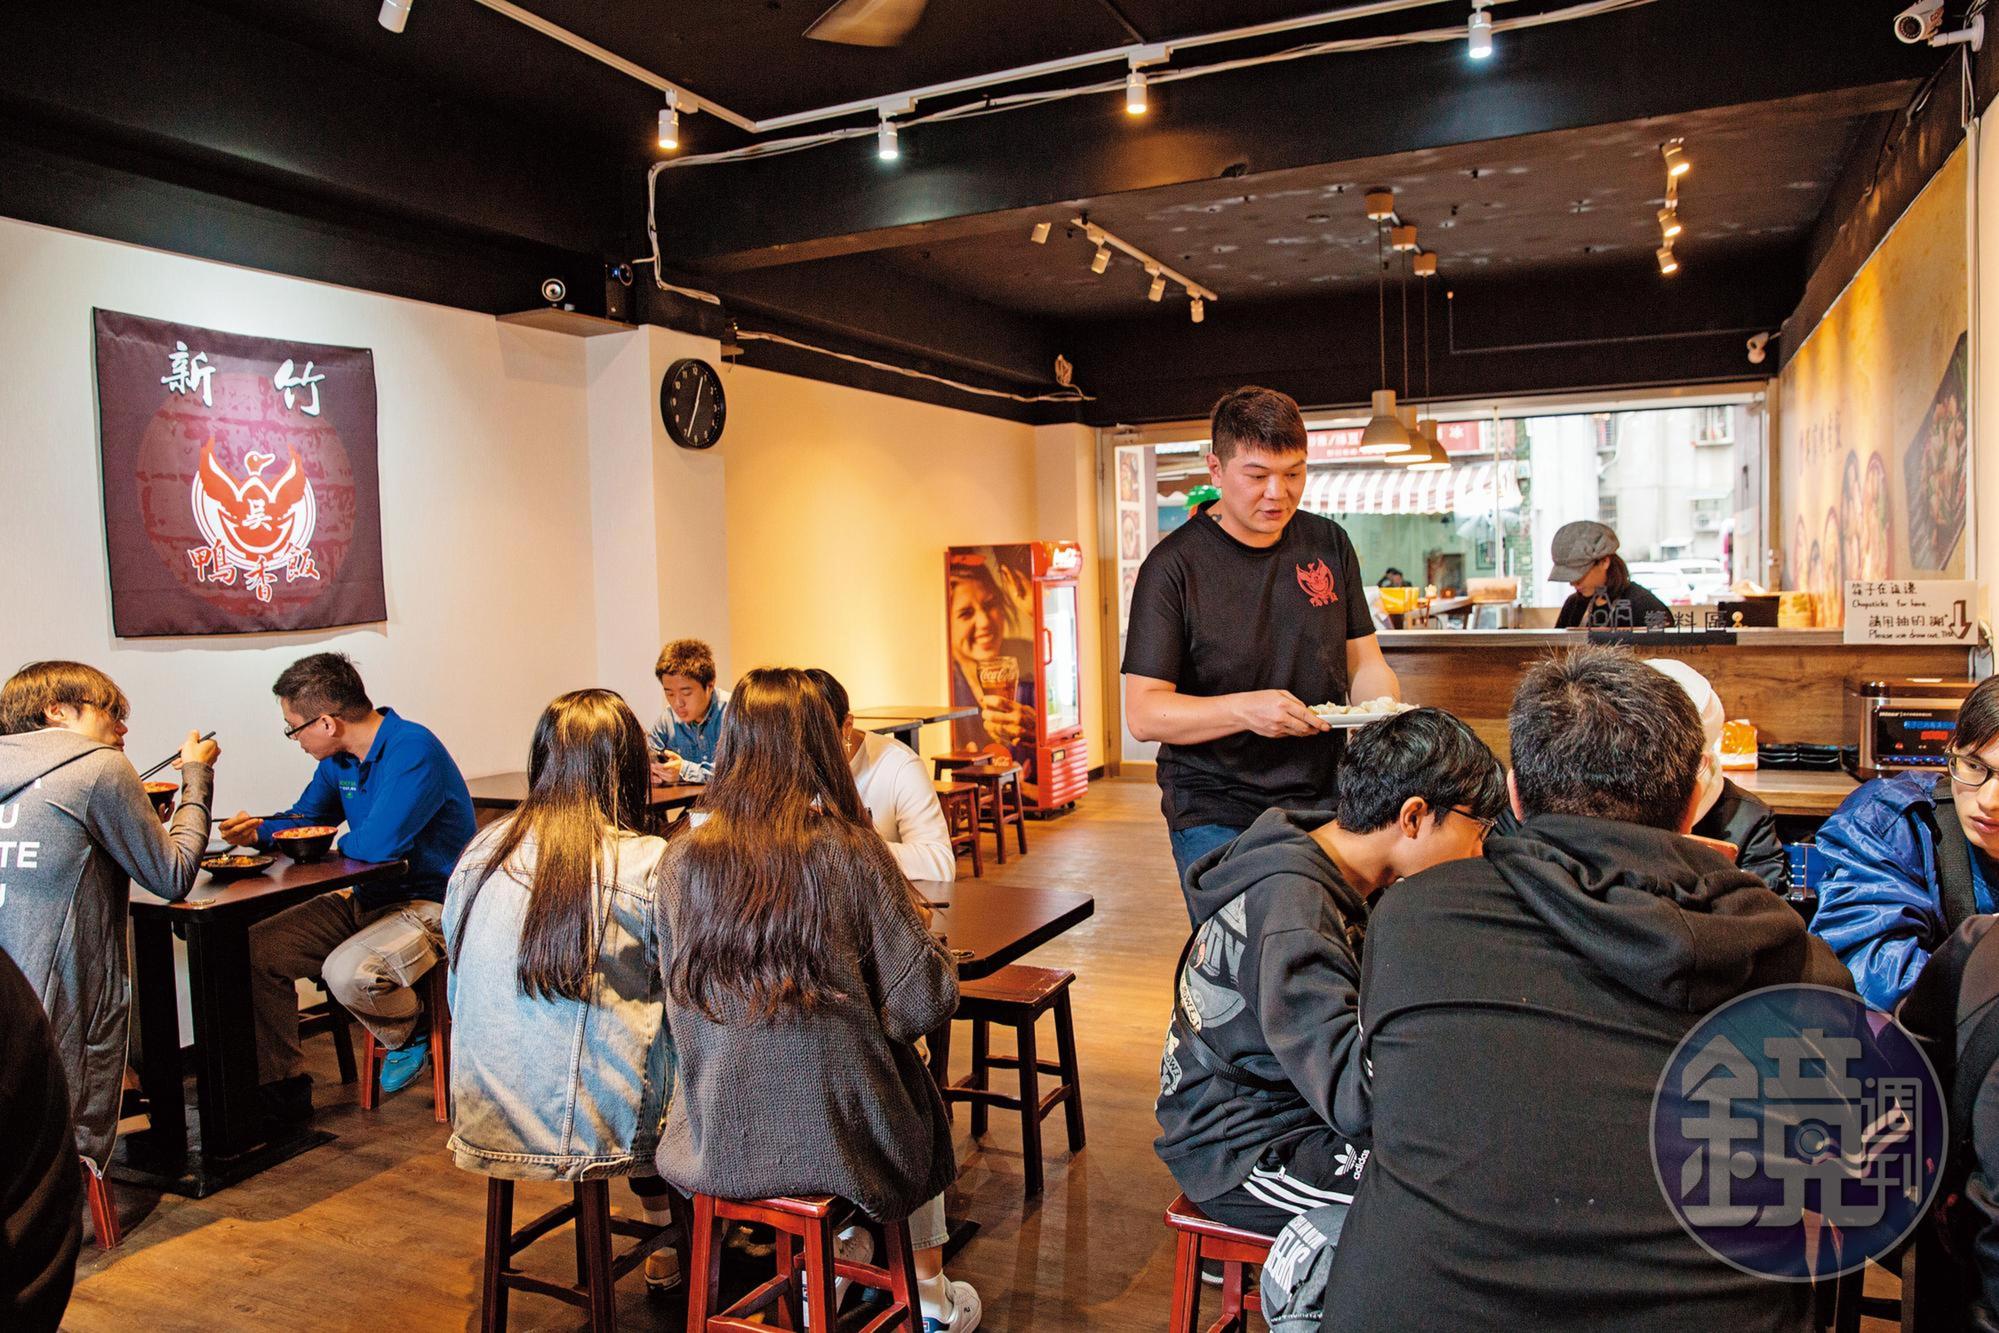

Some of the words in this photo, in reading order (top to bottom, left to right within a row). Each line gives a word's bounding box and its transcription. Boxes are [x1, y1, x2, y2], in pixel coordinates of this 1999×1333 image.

[161, 341, 325, 416] 新竹
[187, 539, 321, 603] 鴨香飯
[1353, 1149, 1371, 1180] adidas
